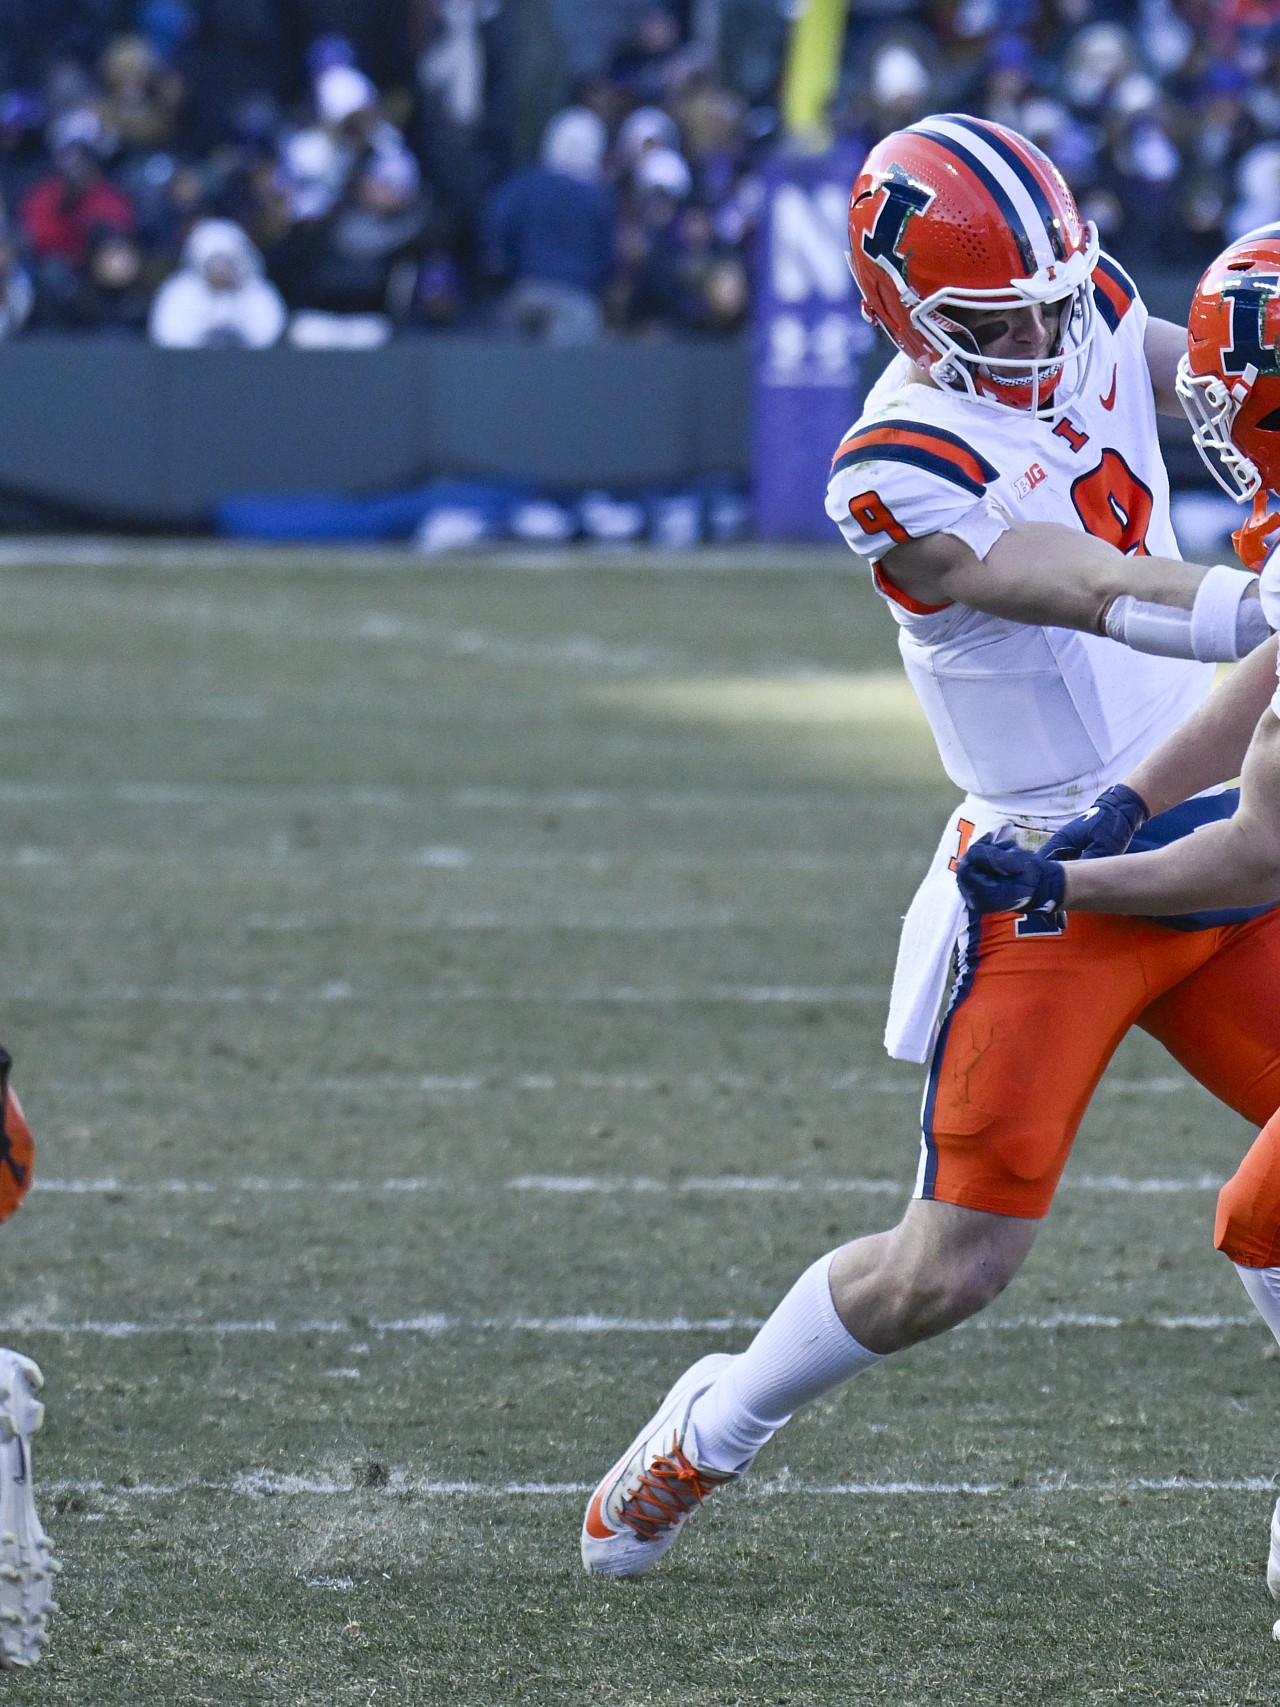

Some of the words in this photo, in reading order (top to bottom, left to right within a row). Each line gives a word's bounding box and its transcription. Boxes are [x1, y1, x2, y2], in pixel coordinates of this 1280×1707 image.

[1051, 417, 1090, 454] I
[848, 490, 914, 544] 9
[1069, 447, 1154, 557] 9
